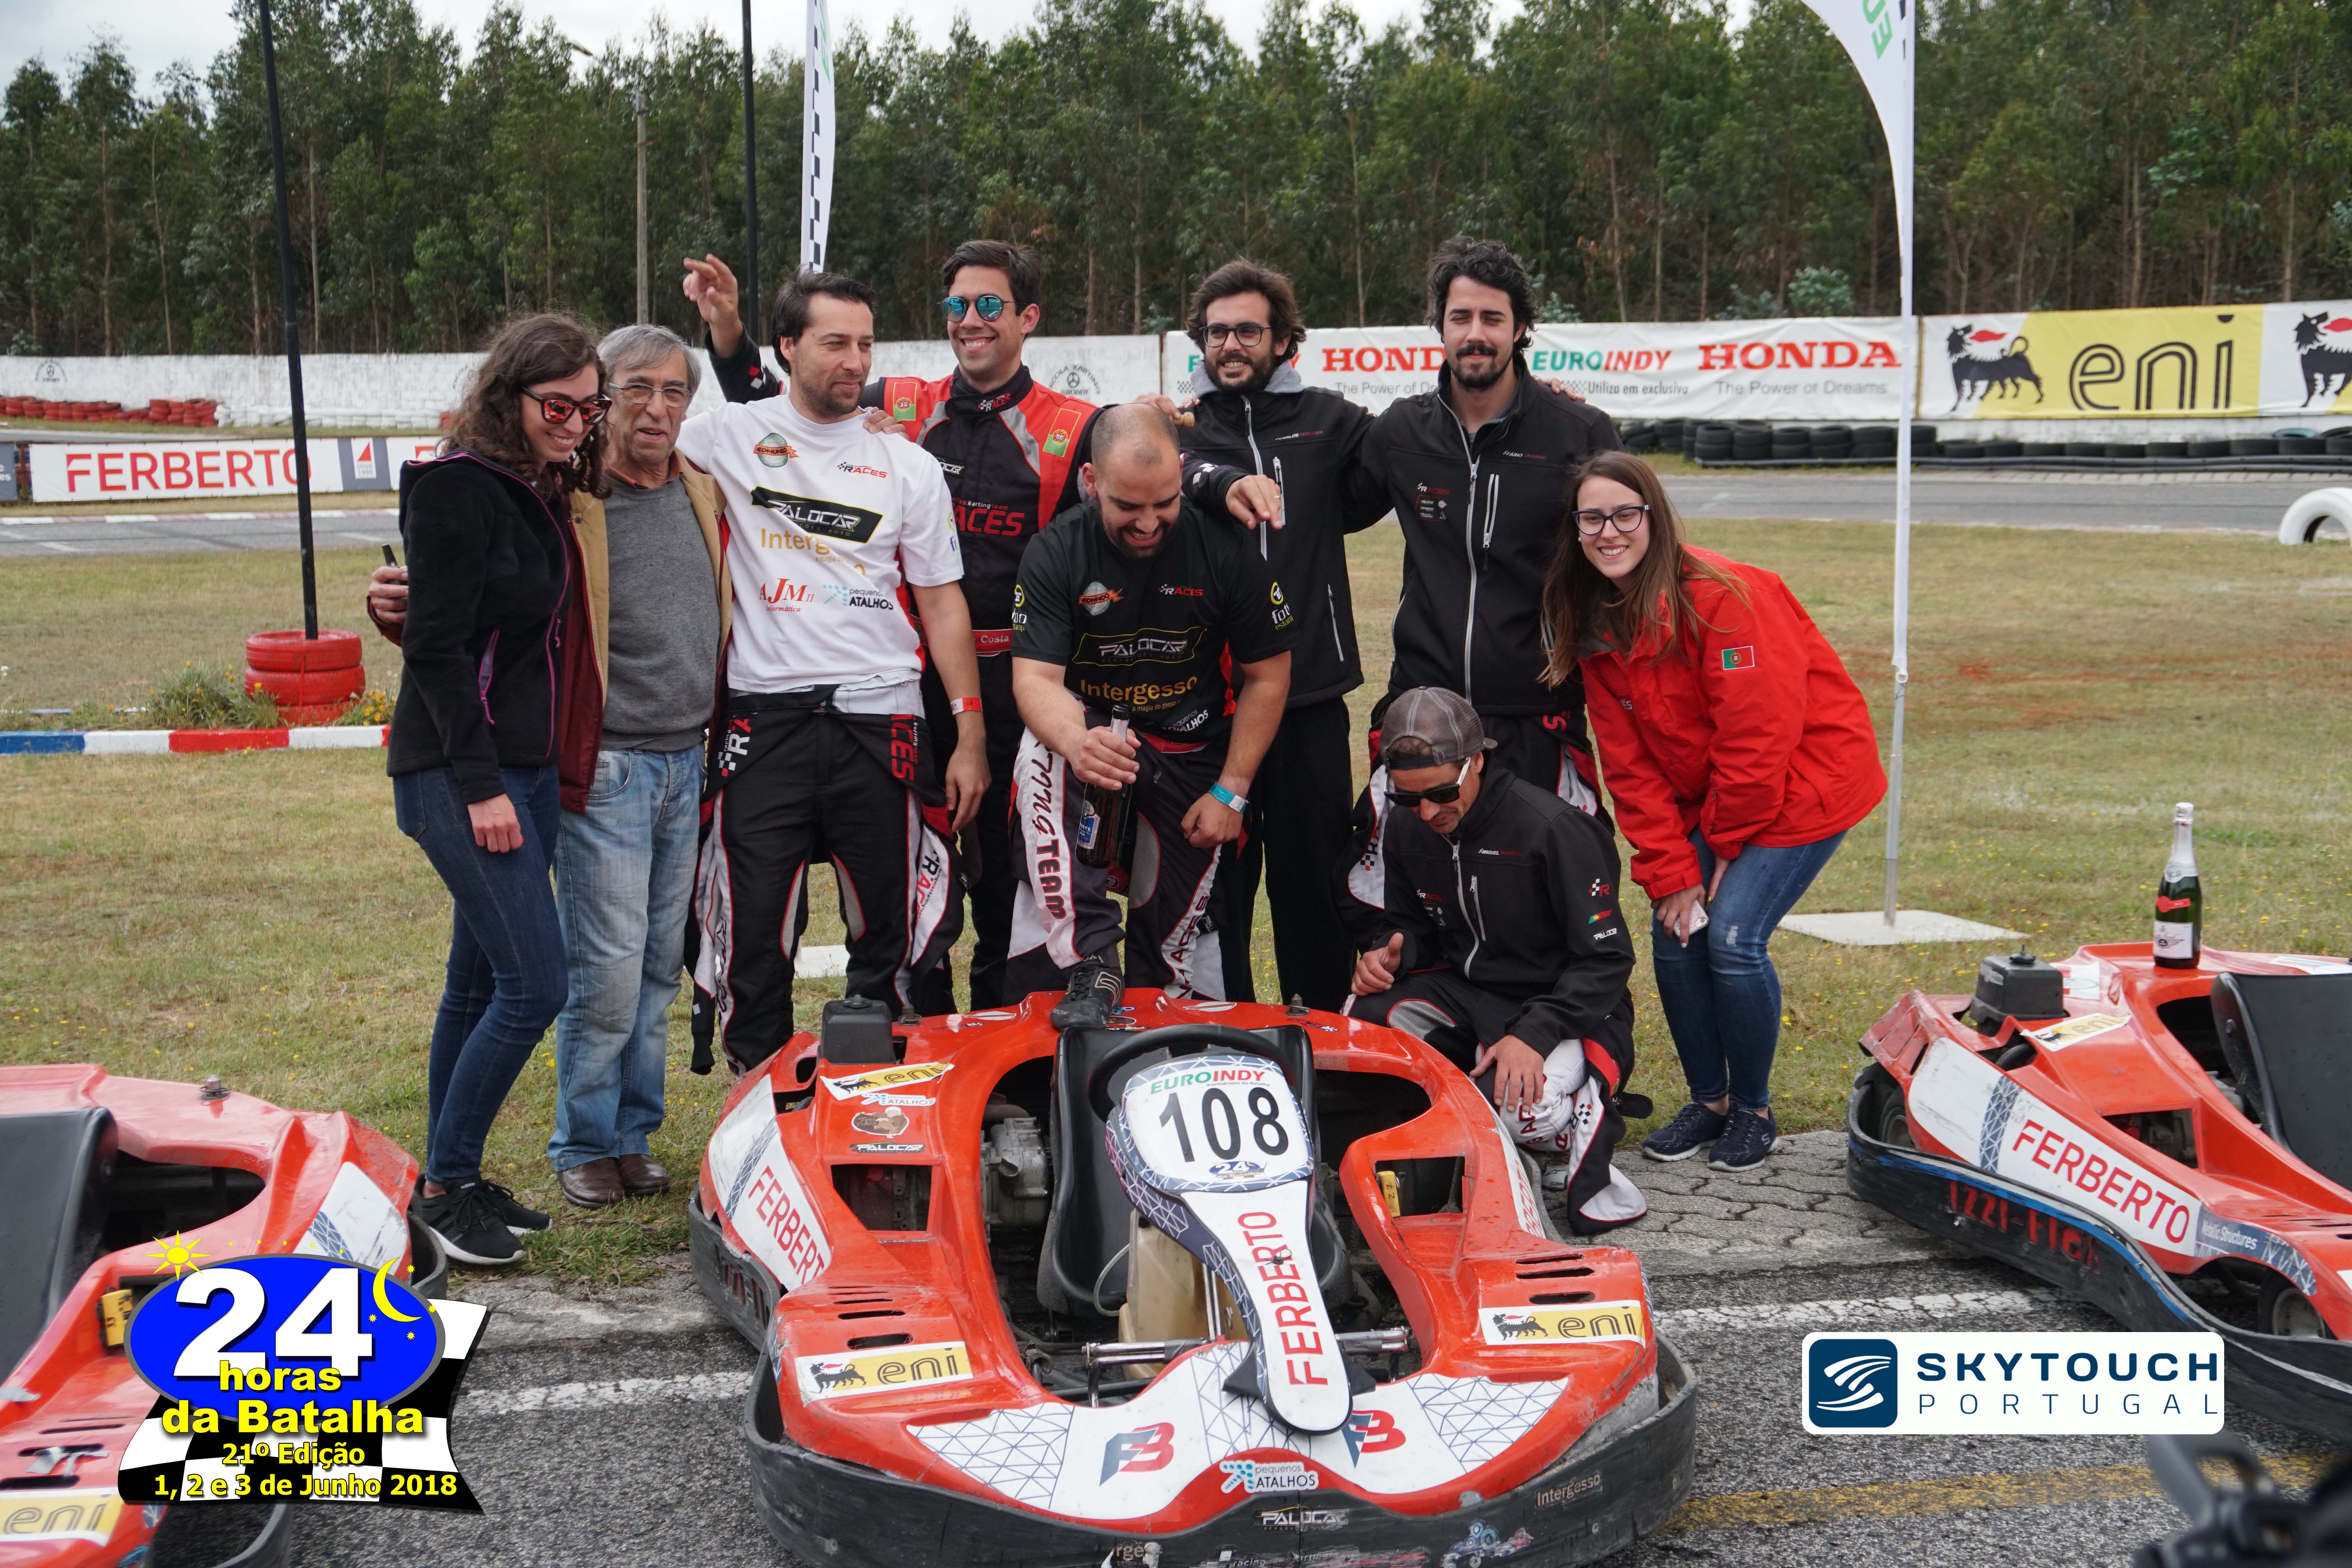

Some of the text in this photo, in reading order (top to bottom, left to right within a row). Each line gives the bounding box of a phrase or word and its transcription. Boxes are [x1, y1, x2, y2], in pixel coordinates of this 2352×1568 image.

[1322, 347, 1446, 372] HOND
[1532, 350, 1672, 371] EUROINDY
[1698, 341, 1902, 370] HONDA
[2069, 314, 2234, 410] eni
[1049, 365, 1069, 389] SCOLA
[1335, 382, 1353, 394] The
[1361, 382, 1401, 394] Power
[1404, 382, 1418, 394] of
[1588, 381, 1619, 394] Utiliza
[1623, 385, 1638, 394] em
[1716, 380, 1889, 395] The Power of Dreams
[843, 465, 887, 478] RACES
[967, 500, 991, 510] karting
[953, 506, 1025, 537] ACES
[1165, 587, 1204, 597] RACES
[980, 635, 1009, 643] Costa
[1098, 638, 1188, 657] PALOCAR
[1080, 676, 1198, 705] Intergesso
[1162, 701, 1176, 711] gesso
[1036, 838, 1066, 920] TEAM
[1150, 1070, 1266, 1095] EUROINDY
[1159, 1087, 1289, 1163] 108
[2013, 1118, 2191, 1244] FERBERTO
[748, 1165, 825, 1286] FERBERT
[2201, 1220, 2258, 1250] Metallic Structures
[1237, 1211, 1329, 1387] FERBERTO
[1557, 1306, 1636, 1339] eni
[877, 1347, 959, 1385] eni
[1256, 1465, 1301, 1474] pequenos
[1256, 1475, 1316, 1489] ATALHOS
[1537, 1474, 1601, 1506] Intergesso
[4, 1494, 106, 1535] eni
